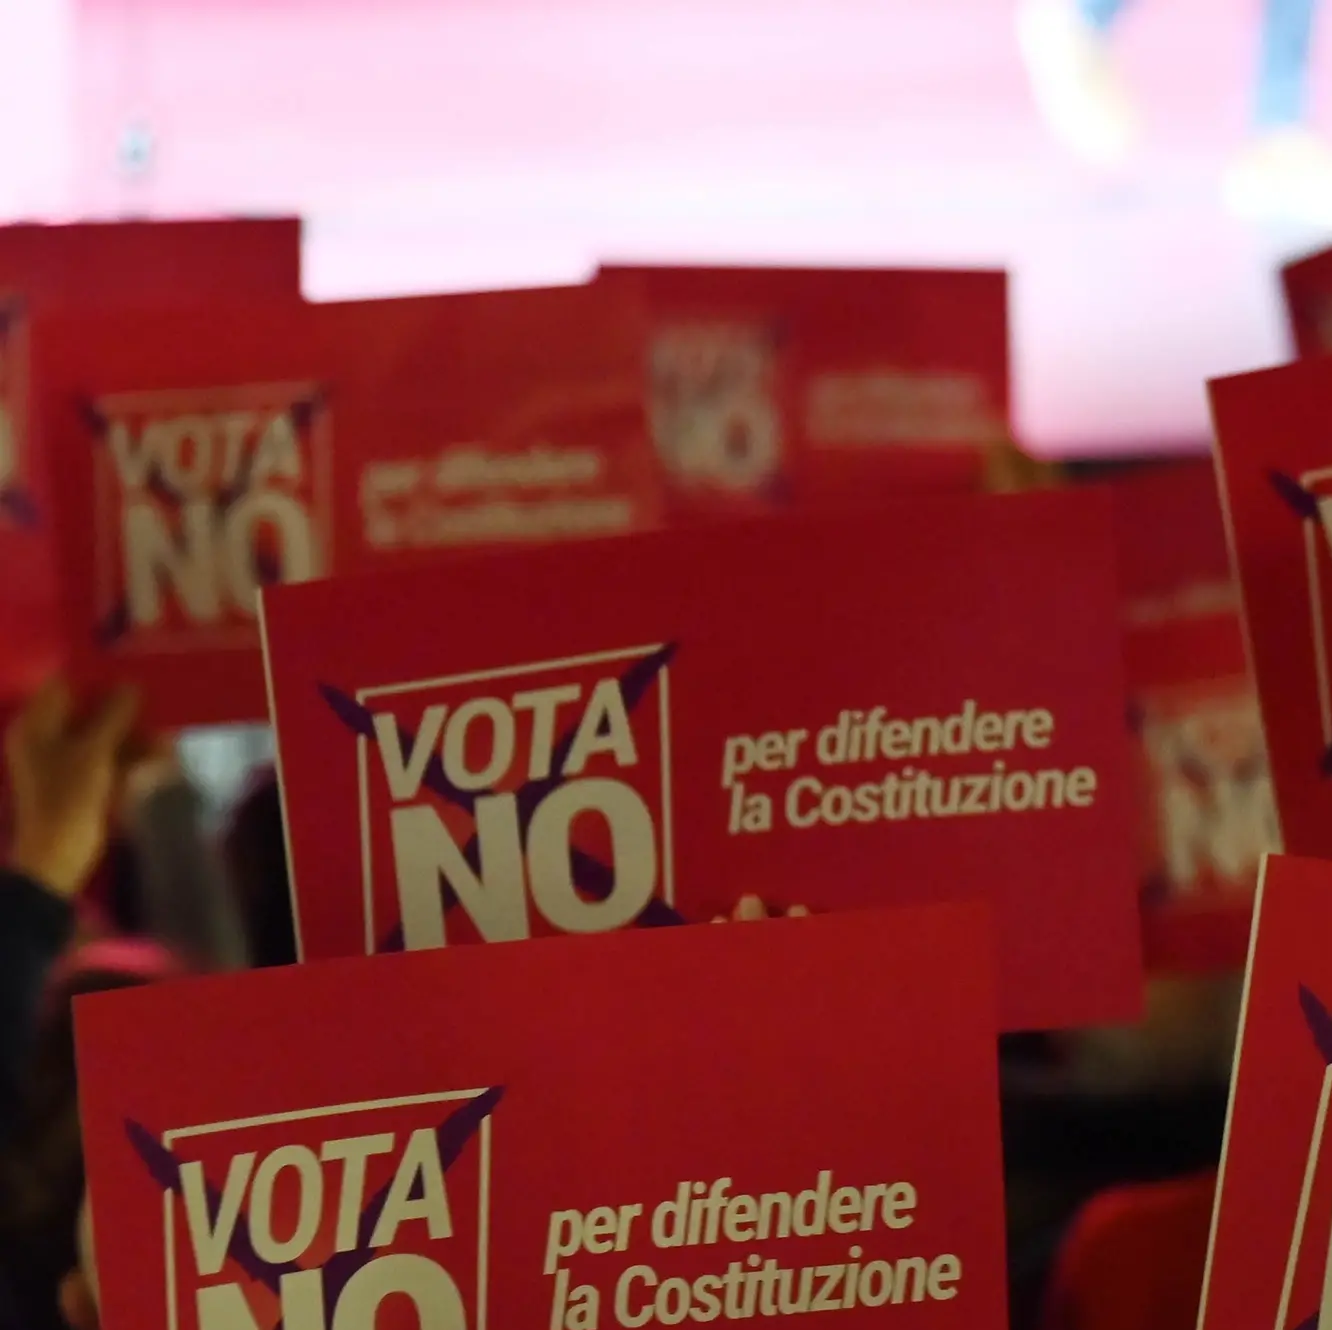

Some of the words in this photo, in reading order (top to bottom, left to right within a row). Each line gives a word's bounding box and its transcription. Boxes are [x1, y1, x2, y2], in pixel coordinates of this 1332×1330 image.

[107, 410, 300, 496] VOTA
[120, 490, 325, 624] NO
[373, 678, 638, 800] VOTA
[722, 725, 807, 789] per
[816, 699, 1054, 766] difendere
[728, 783, 771, 834] la
[785, 759, 1097, 828] Costituzione
[391, 778, 657, 950] NO
[179, 1127, 453, 1276] VOTA
[544, 1203, 642, 1274] per
[651, 1170, 917, 1248] difendere
[614, 1248, 962, 1329] Costituzione
